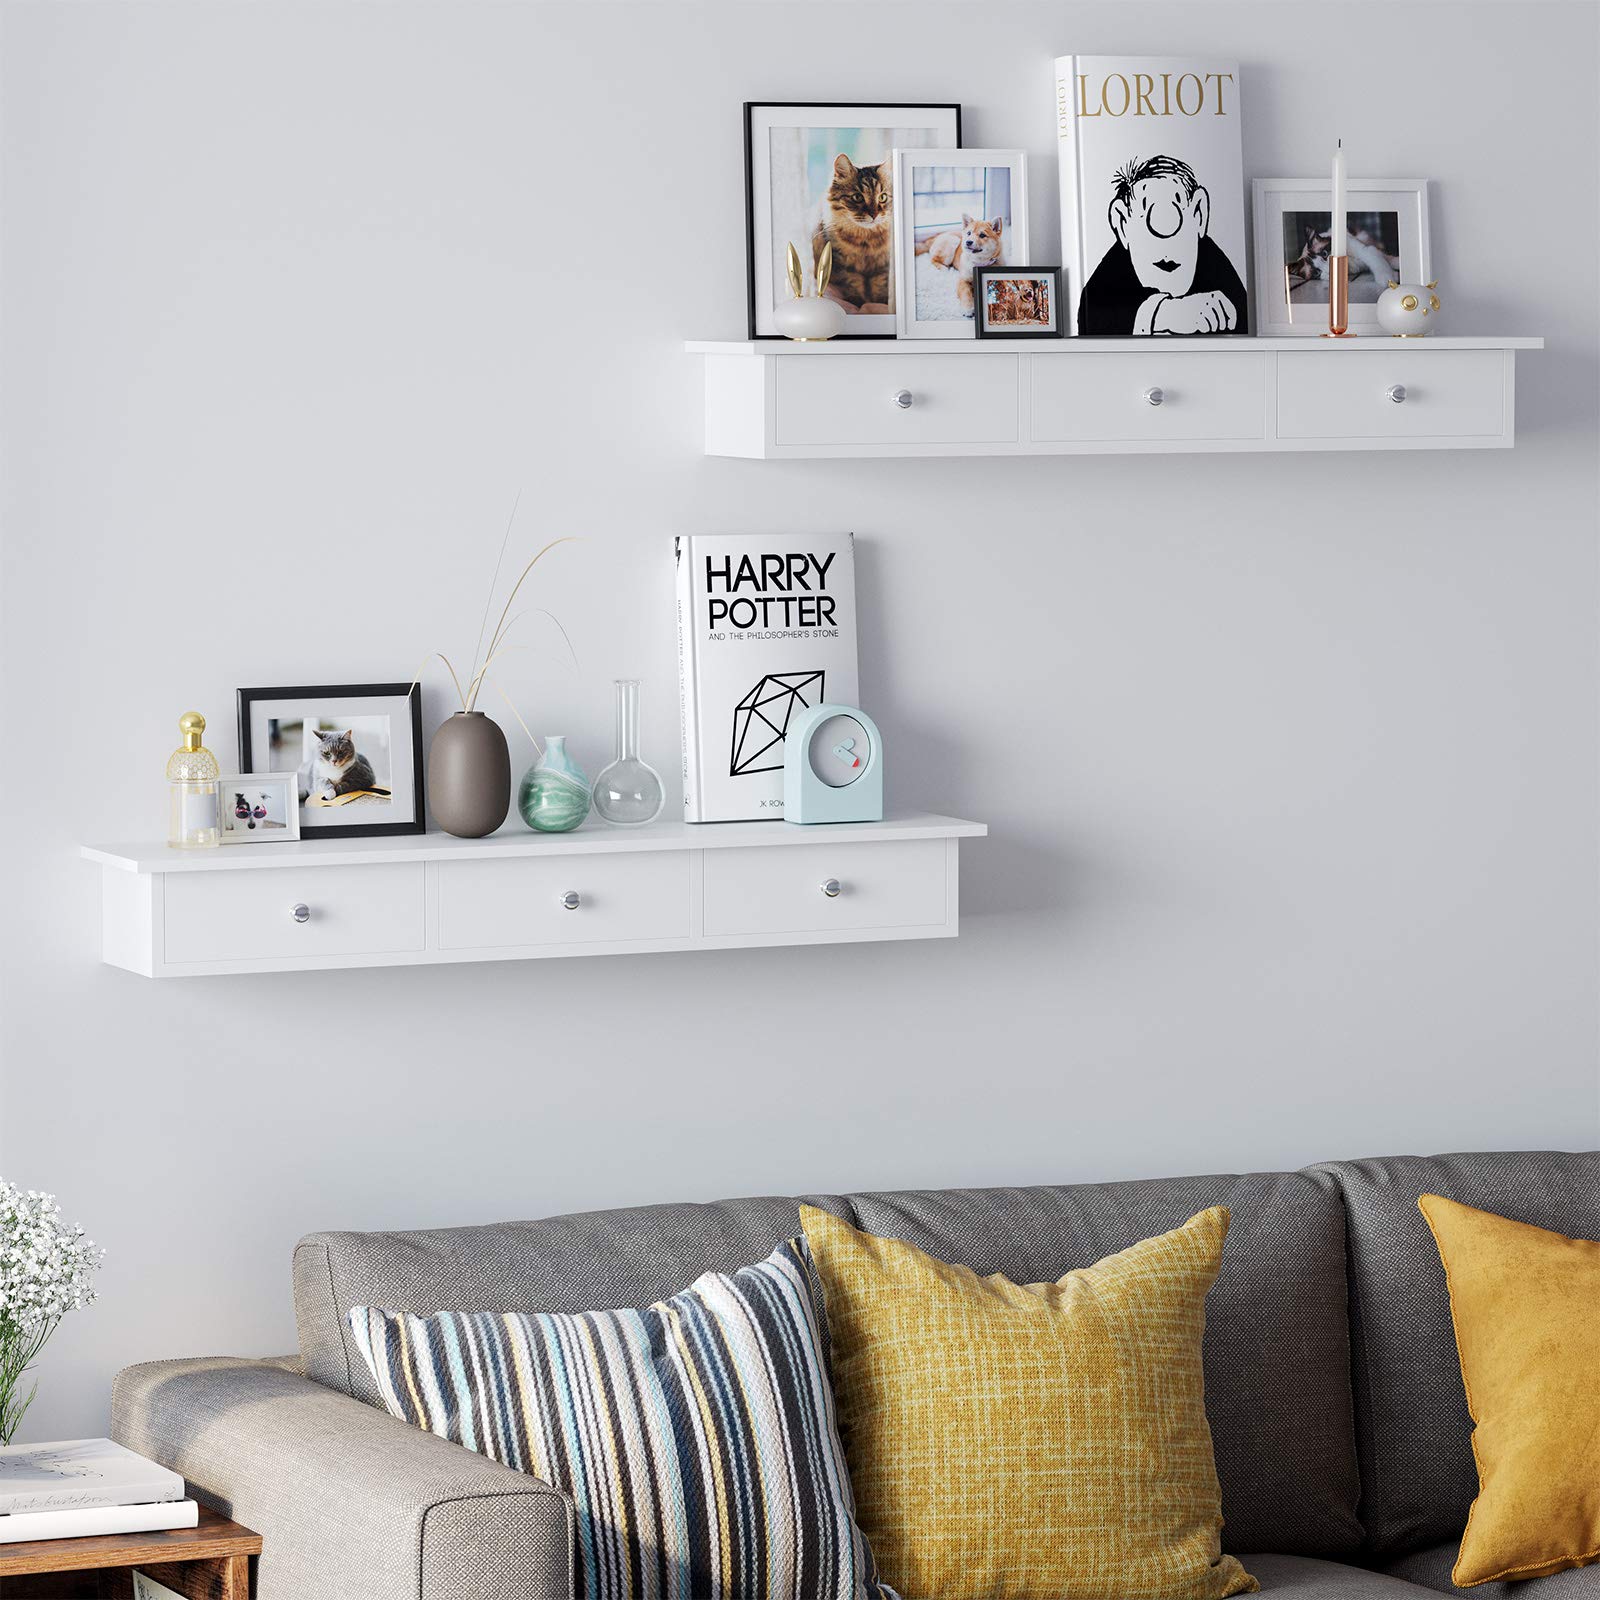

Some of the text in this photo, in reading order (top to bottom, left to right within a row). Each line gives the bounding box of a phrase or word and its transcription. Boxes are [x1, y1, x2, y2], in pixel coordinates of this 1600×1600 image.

[1057, 77, 1069, 138] LORIOT
[1076, 73, 1234, 117] LORIOT
[705, 552, 836, 593] HARRY
[708, 595, 838, 630] POTTER
[708, 629, 839, 641] AND THE PHILOSOPHER'S STONE
[769, 799, 785, 808] ROW
